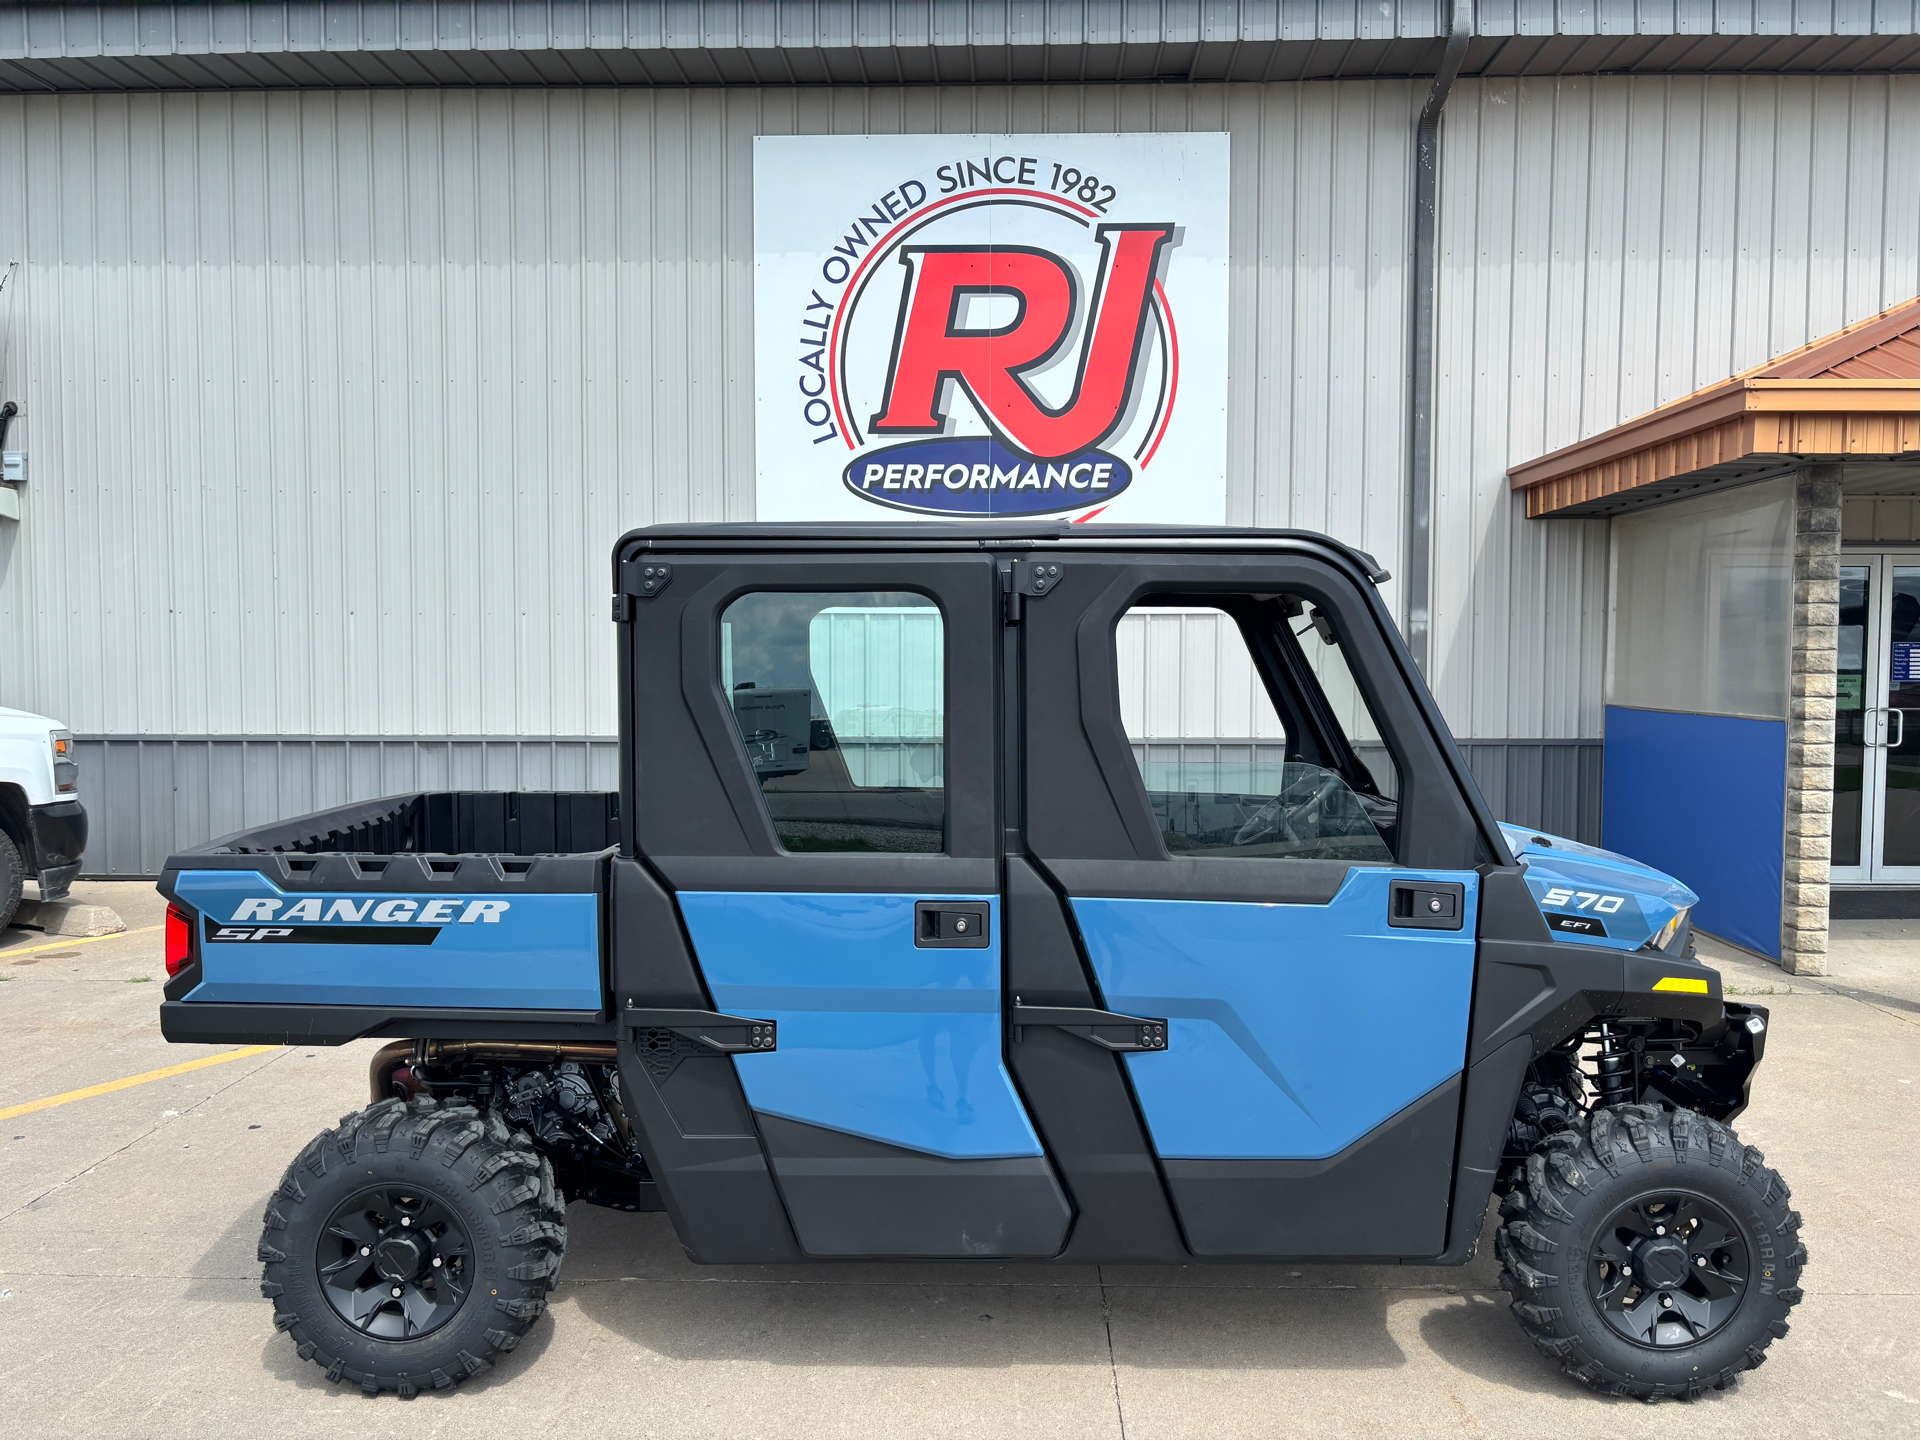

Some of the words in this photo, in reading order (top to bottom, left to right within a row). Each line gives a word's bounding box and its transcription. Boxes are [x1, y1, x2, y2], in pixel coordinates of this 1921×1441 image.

[798, 289, 838, 445] LOCALLY
[823, 180, 928, 284] OWNED
[936, 156, 1038, 193] SINCE
[1050, 163, 1117, 214] 1982
[867, 222, 1176, 464] RJ
[862, 462, 1114, 491] PERFORMANCE
[230, 898, 511, 923] RANGER
[1541, 888, 1625, 913] 570
[1560, 920, 1591, 930] EFI
[211, 928, 294, 940] SP
[432, 1176, 464, 1204] PRO
[461, 1204, 495, 1263] ARMOR
[1726, 1189, 1776, 1296] X-TERRAIN
[288, 1254, 354, 1355] X-TERRAIN
